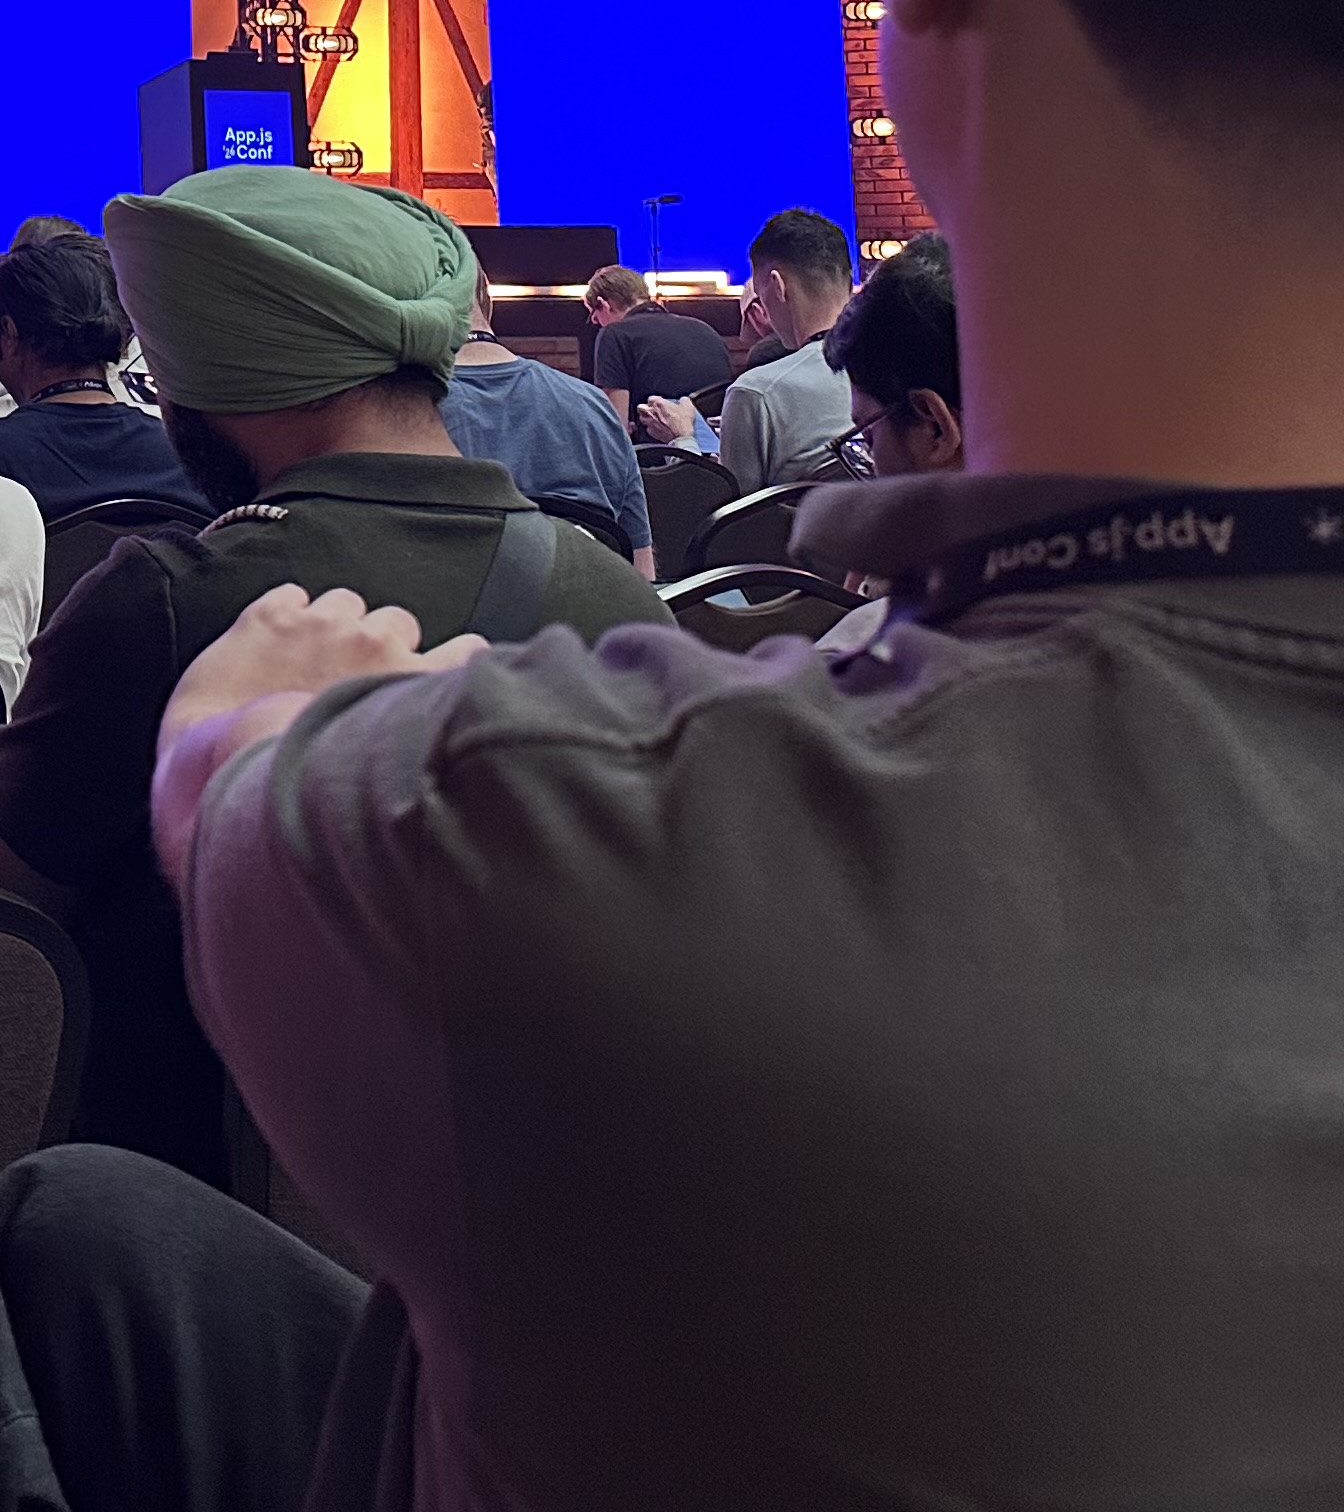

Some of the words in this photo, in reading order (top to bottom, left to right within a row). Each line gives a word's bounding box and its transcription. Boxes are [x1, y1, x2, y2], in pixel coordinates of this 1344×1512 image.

[224, 127, 273, 145] App.js
[236, 144, 273, 159] Conf
[982, 533, 1079, 583] Conf
